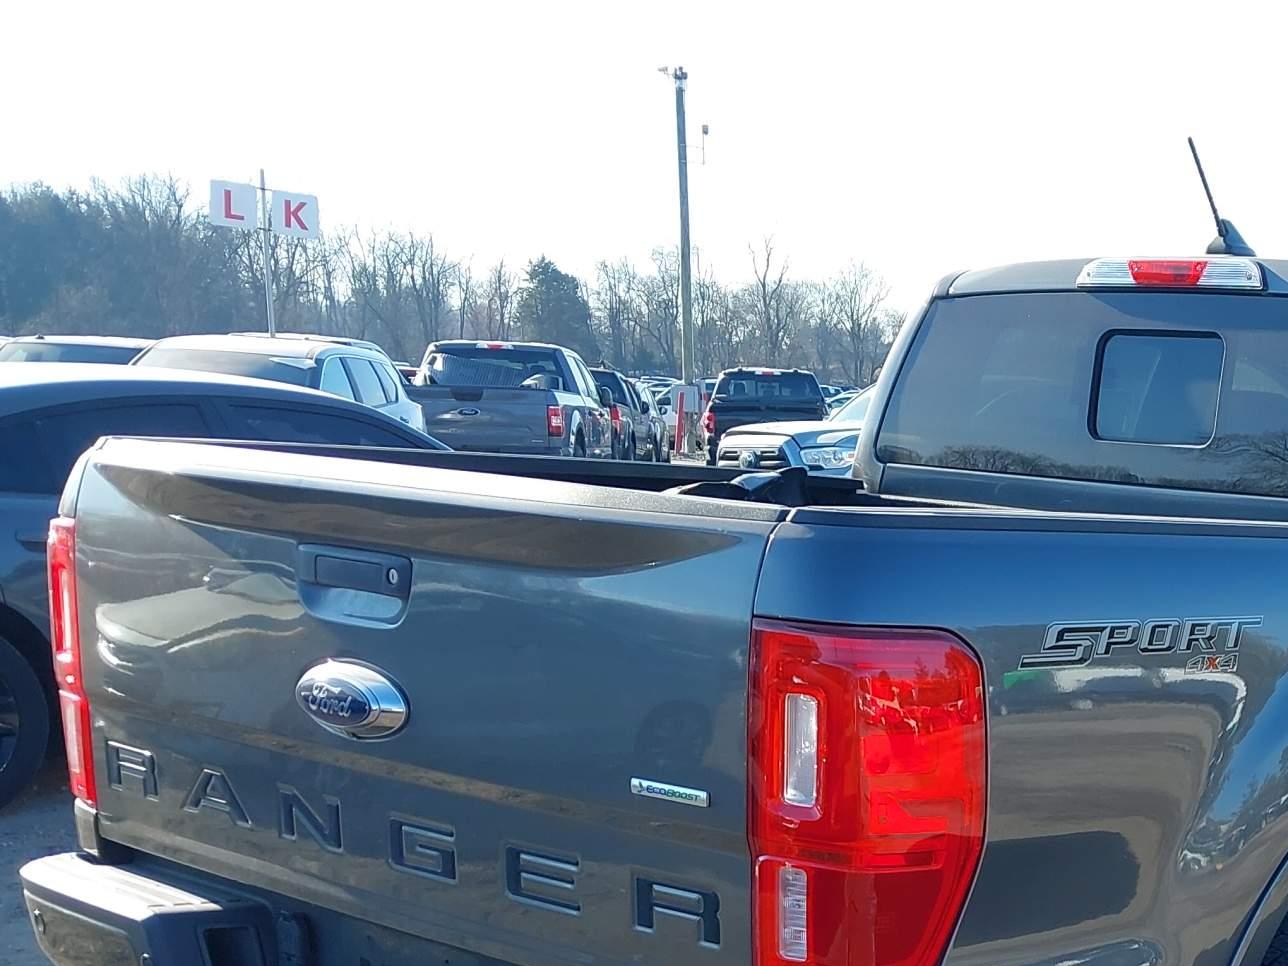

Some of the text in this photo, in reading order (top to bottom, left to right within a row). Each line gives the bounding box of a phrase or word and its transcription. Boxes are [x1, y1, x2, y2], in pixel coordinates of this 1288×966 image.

[223, 188, 308, 231] L K
[1016, 615, 1264, 670] SPORT
[301, 682, 352, 716] Ford
[105, 738, 723, 951] RANGER
